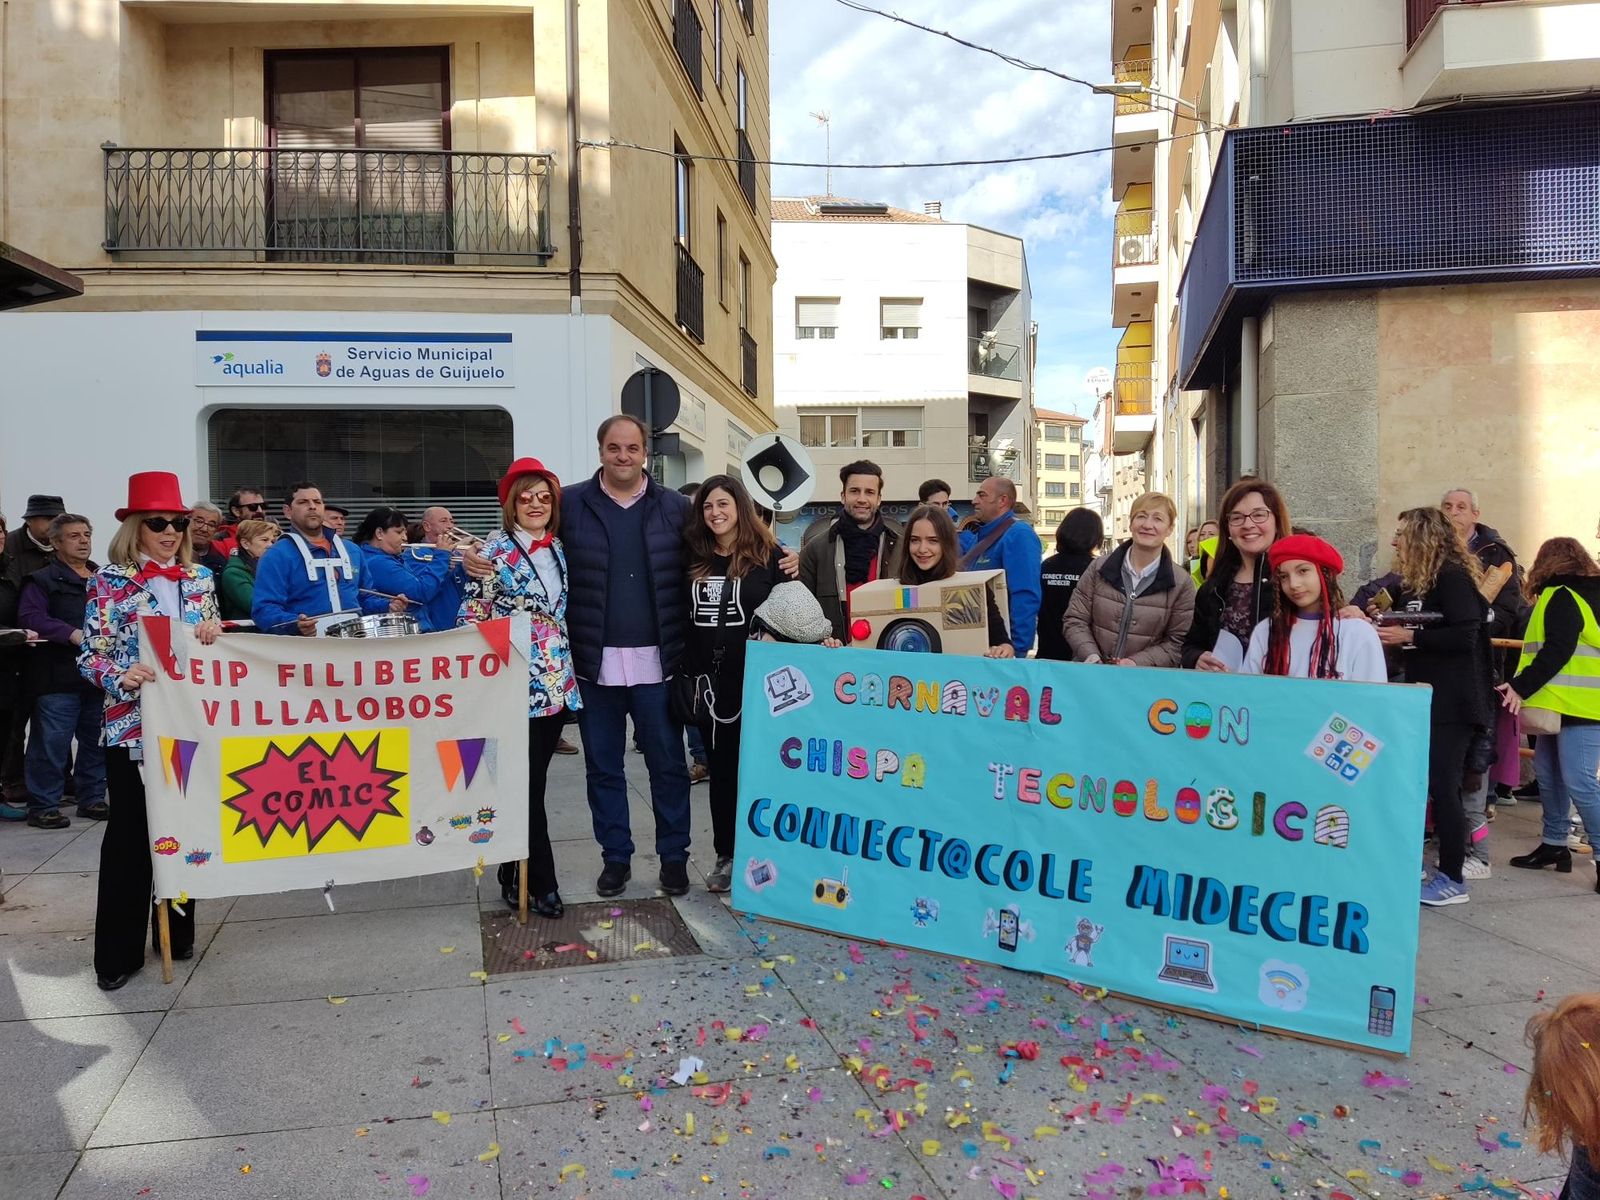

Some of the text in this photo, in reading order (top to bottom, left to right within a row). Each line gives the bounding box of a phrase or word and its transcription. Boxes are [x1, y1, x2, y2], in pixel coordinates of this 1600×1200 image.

[222, 360, 284, 378] aqualia
[347, 347, 493, 363] Servicio Municipal
[336, 366, 505, 381] de Aguas de Guijuelo
[167, 652, 501, 688] CEIP FILIBERTO
[201, 693, 455, 727] VILLALOBOS
[834, 671, 1250, 746] CARNAVAL CON
[299, 759, 336, 784] EL
[261, 782, 373, 815] COMIC
[780, 737, 1350, 849] CHISPA TECNOLÓGICA
[747, 798, 1370, 955] CONNECT@COLE MIDECER
